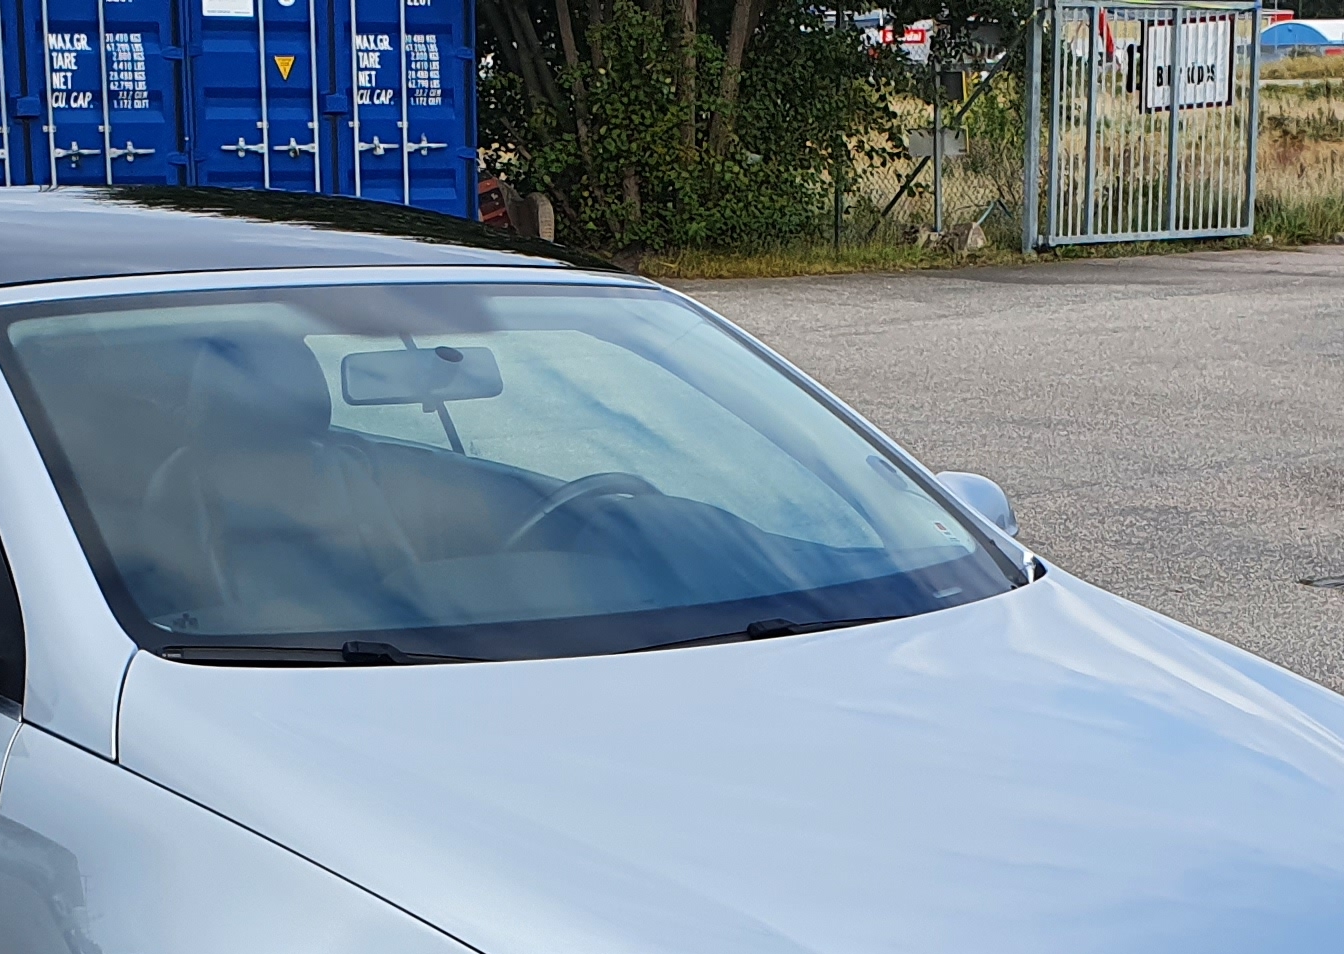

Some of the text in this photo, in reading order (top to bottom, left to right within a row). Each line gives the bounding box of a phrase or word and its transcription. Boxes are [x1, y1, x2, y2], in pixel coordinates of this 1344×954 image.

[51, 52, 78, 69] TARE
[358, 52, 381, 68] TARE
[52, 72, 73, 89] NET
[358, 71, 376, 87] NET
[70, 92, 93, 108] CAP.
[373, 89, 394, 105] CAP.
